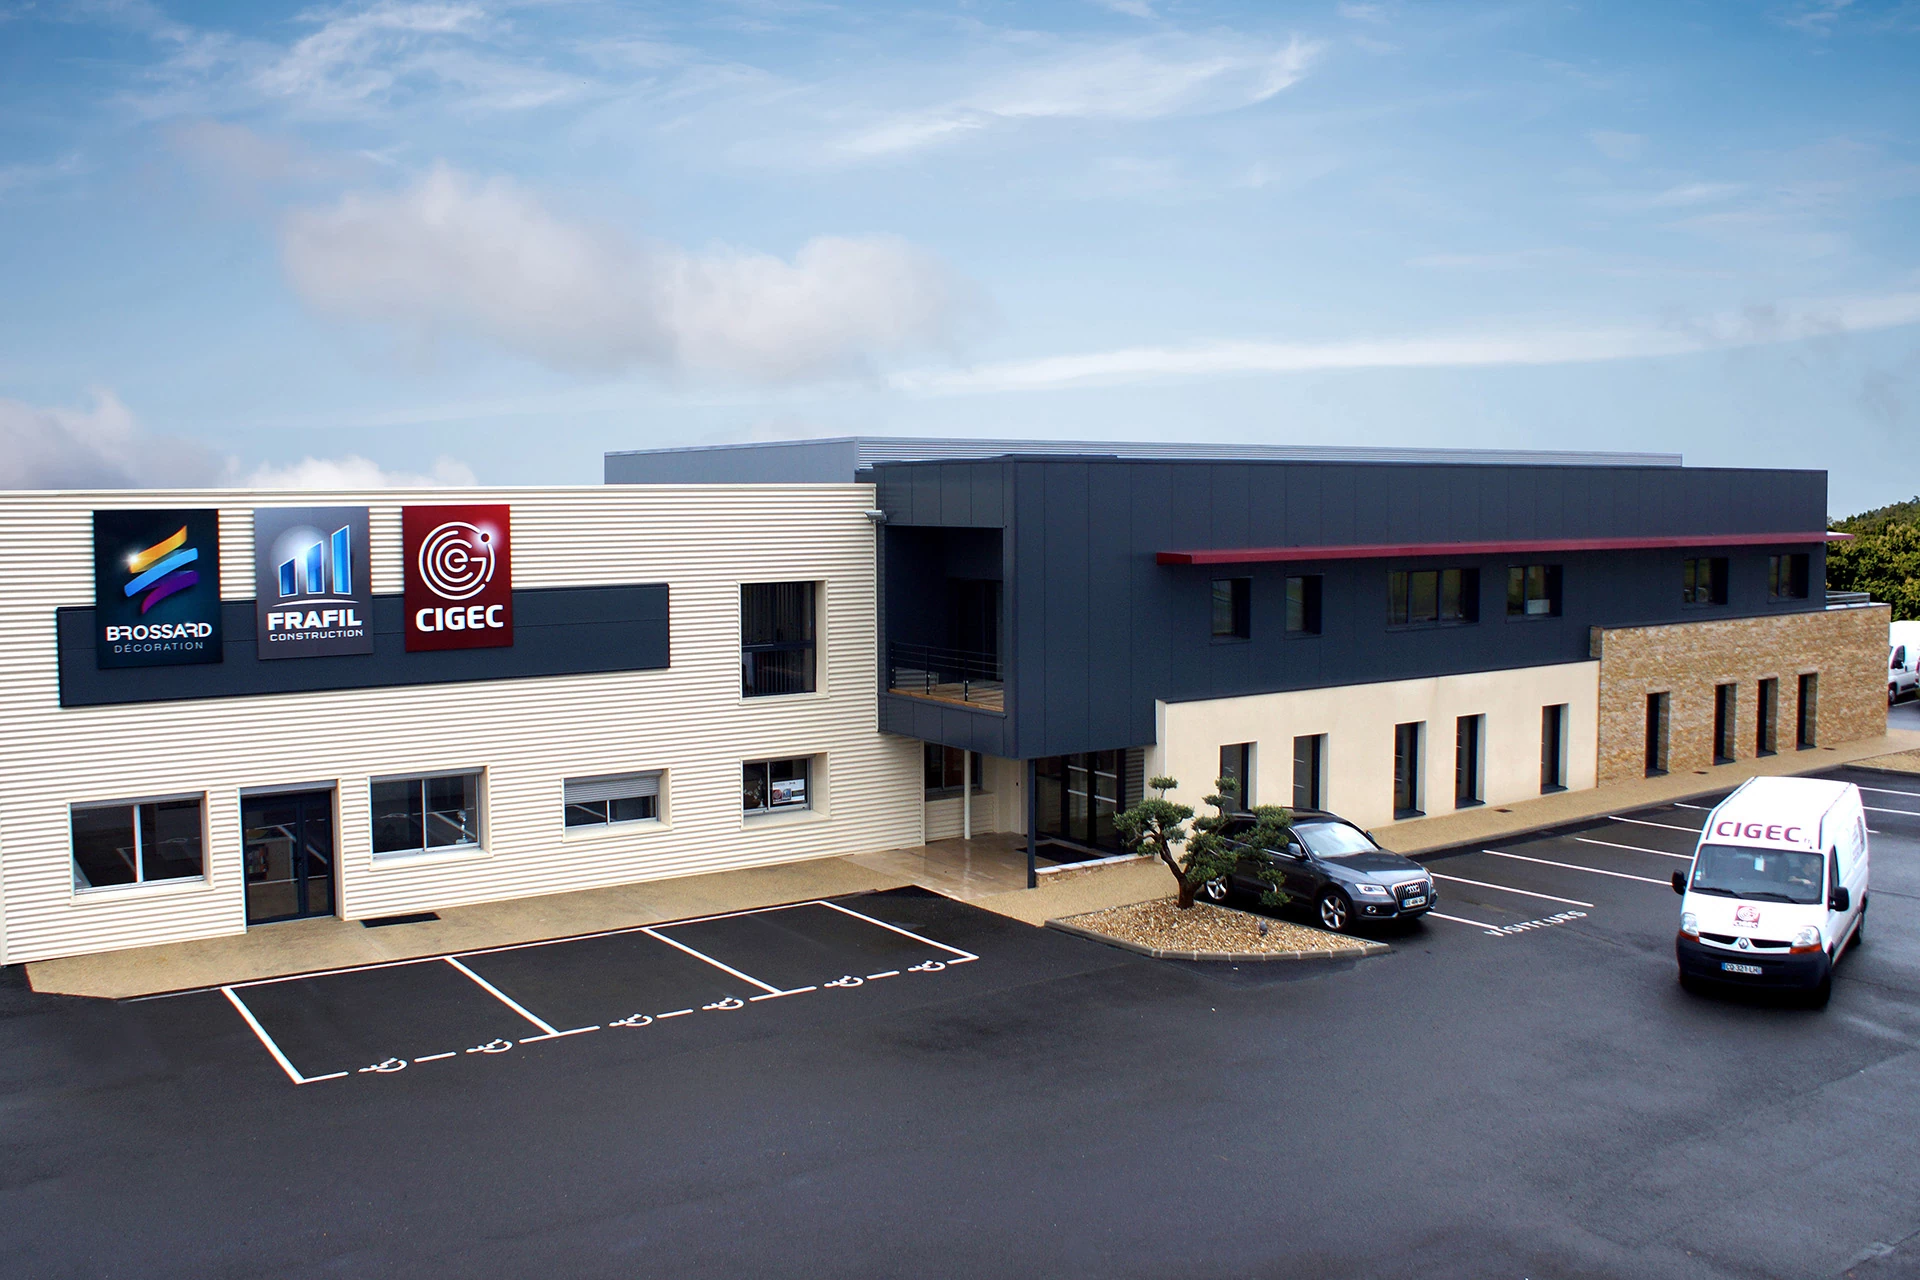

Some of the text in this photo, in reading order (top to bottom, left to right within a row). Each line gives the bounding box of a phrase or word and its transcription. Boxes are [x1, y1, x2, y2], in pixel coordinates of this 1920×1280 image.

[267, 608, 363, 631] FRAFIL
[415, 604, 504, 632] CIGEC
[105, 622, 213, 641] BROSSARD
[269, 629, 364, 642] CONSTRUCTION
[114, 641, 204, 654] DÉCORATION
[1716, 821, 1801, 843] CIGEC
[1483, 910, 1588, 937] VISITEURS
